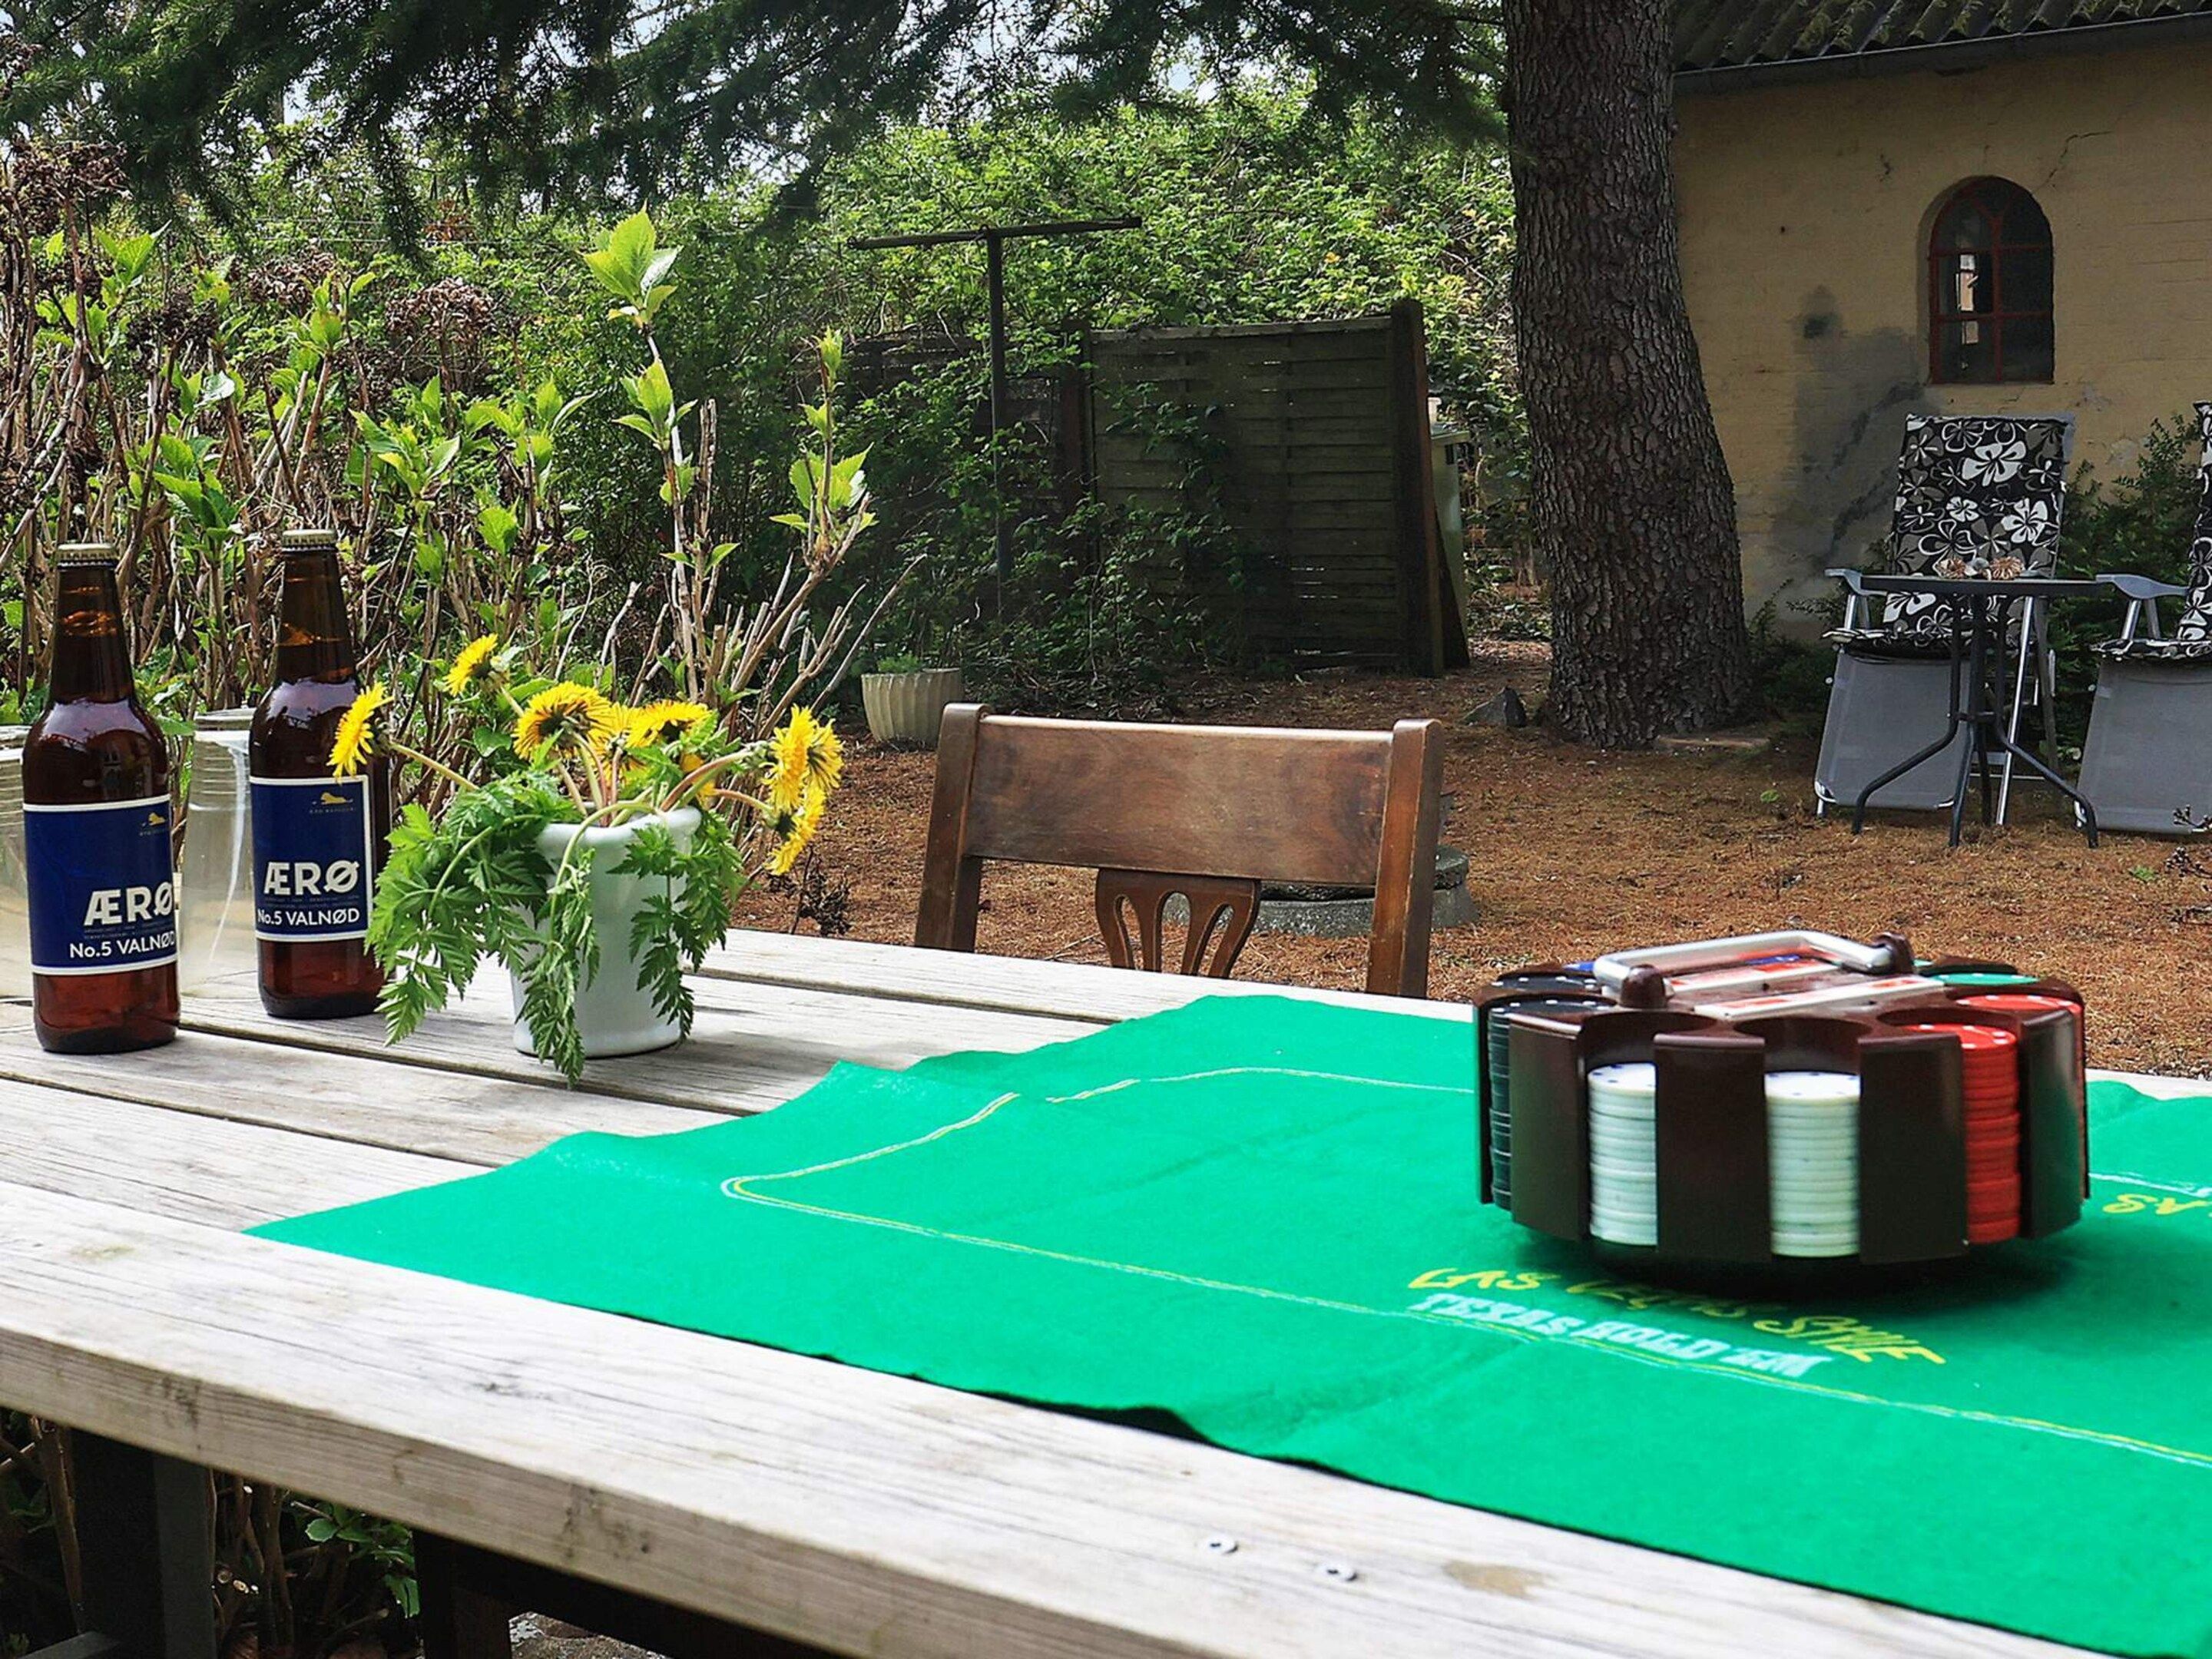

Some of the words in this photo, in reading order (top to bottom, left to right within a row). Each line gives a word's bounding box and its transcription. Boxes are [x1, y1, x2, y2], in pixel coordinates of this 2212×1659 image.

[263, 859, 360, 896] ÆRØ
[83, 882, 173, 926] ÆRØ
[257, 908, 283, 926] No.5
[286, 908, 360, 926] VALNØD
[69, 941, 112, 959] No.5
[1407, 1267, 1562, 1291] LAS
[1407, 1293, 1585, 1336] TEXAS
[1569, 1320, 1732, 1360] HOLD
